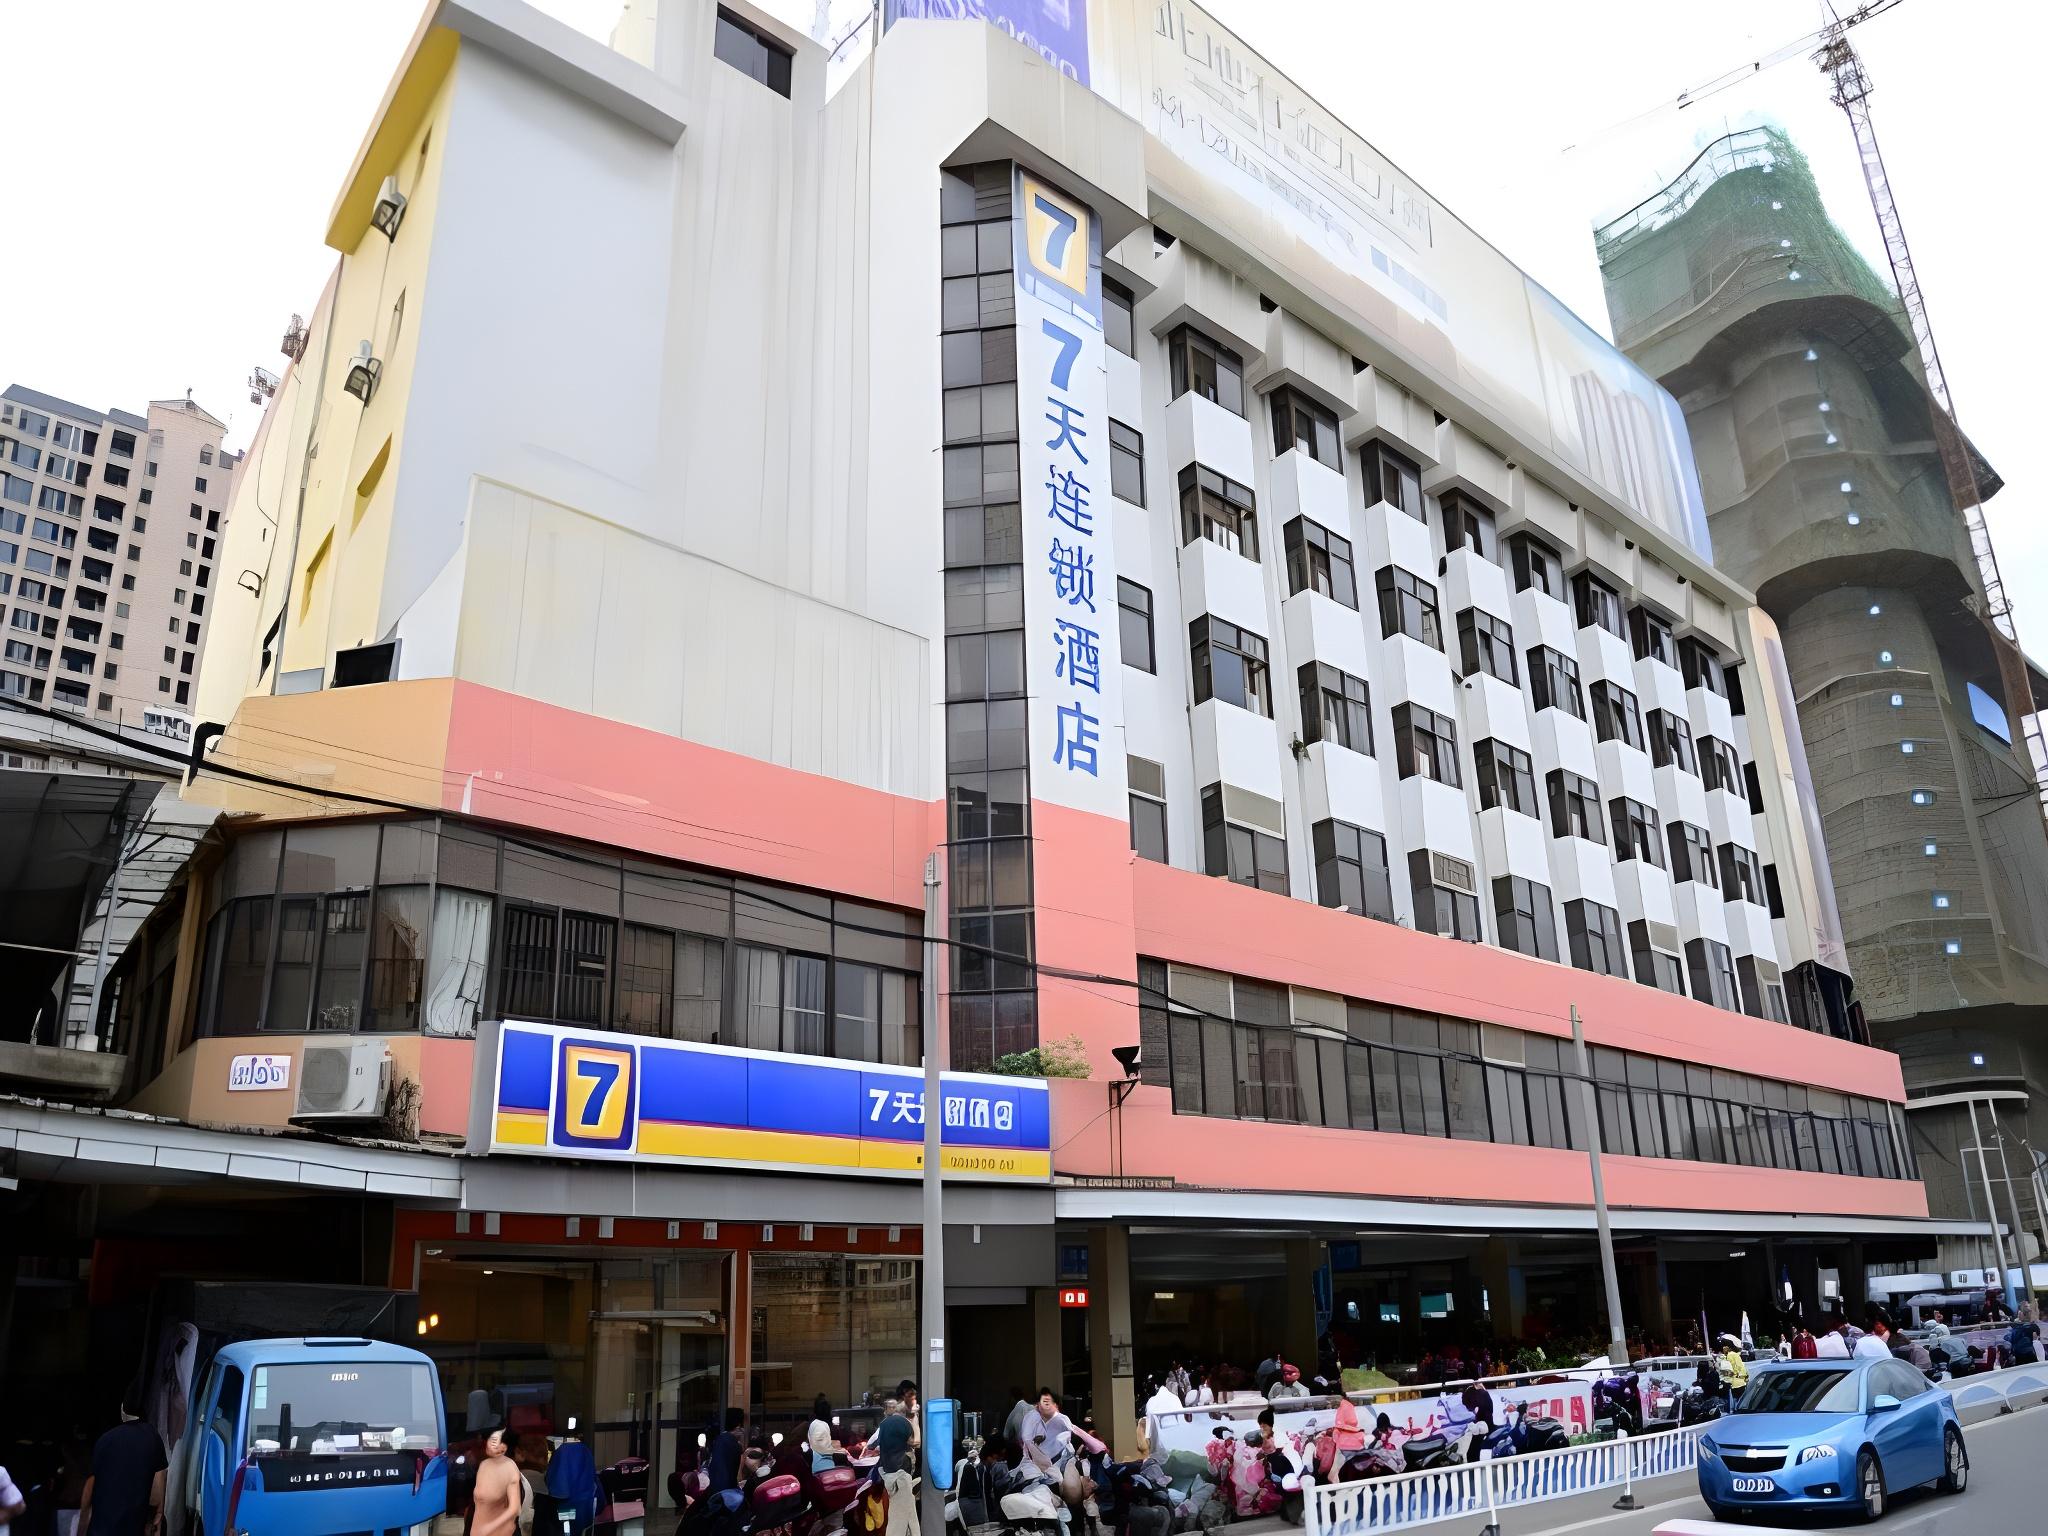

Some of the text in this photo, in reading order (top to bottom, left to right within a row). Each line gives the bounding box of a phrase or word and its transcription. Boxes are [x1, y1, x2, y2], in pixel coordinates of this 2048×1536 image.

[1042, 317, 1100, 778] 7天连锁酒店
[577, 1059, 620, 1126] 7
